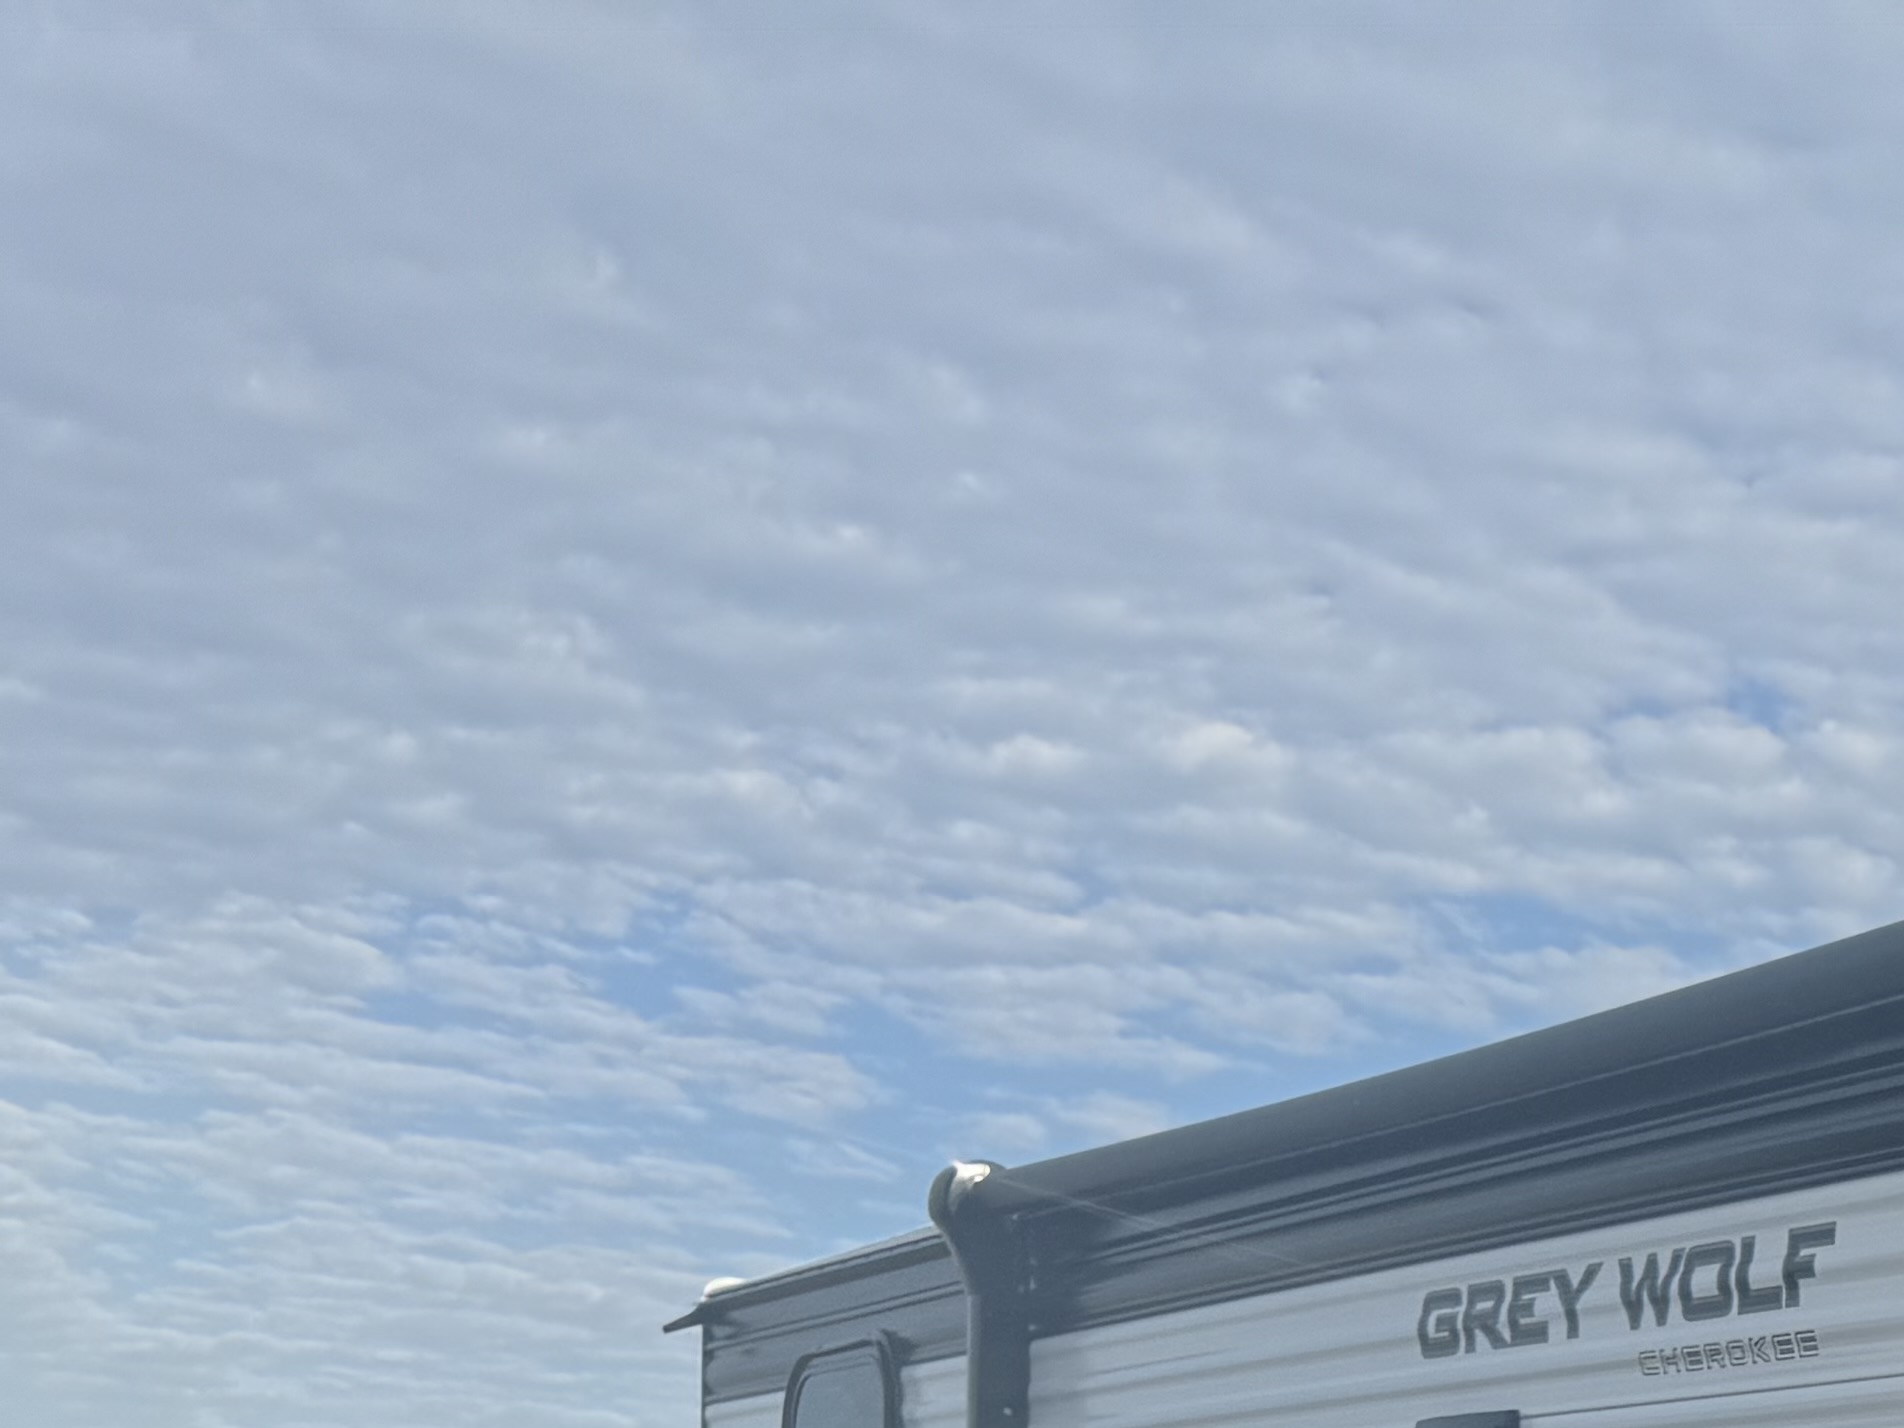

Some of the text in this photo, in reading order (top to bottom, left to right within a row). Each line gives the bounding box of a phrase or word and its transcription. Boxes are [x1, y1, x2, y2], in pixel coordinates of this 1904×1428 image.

[1417, 1220, 1838, 1360] GREY WOLF
[1638, 1329, 1821, 1377] CHEROKEE
